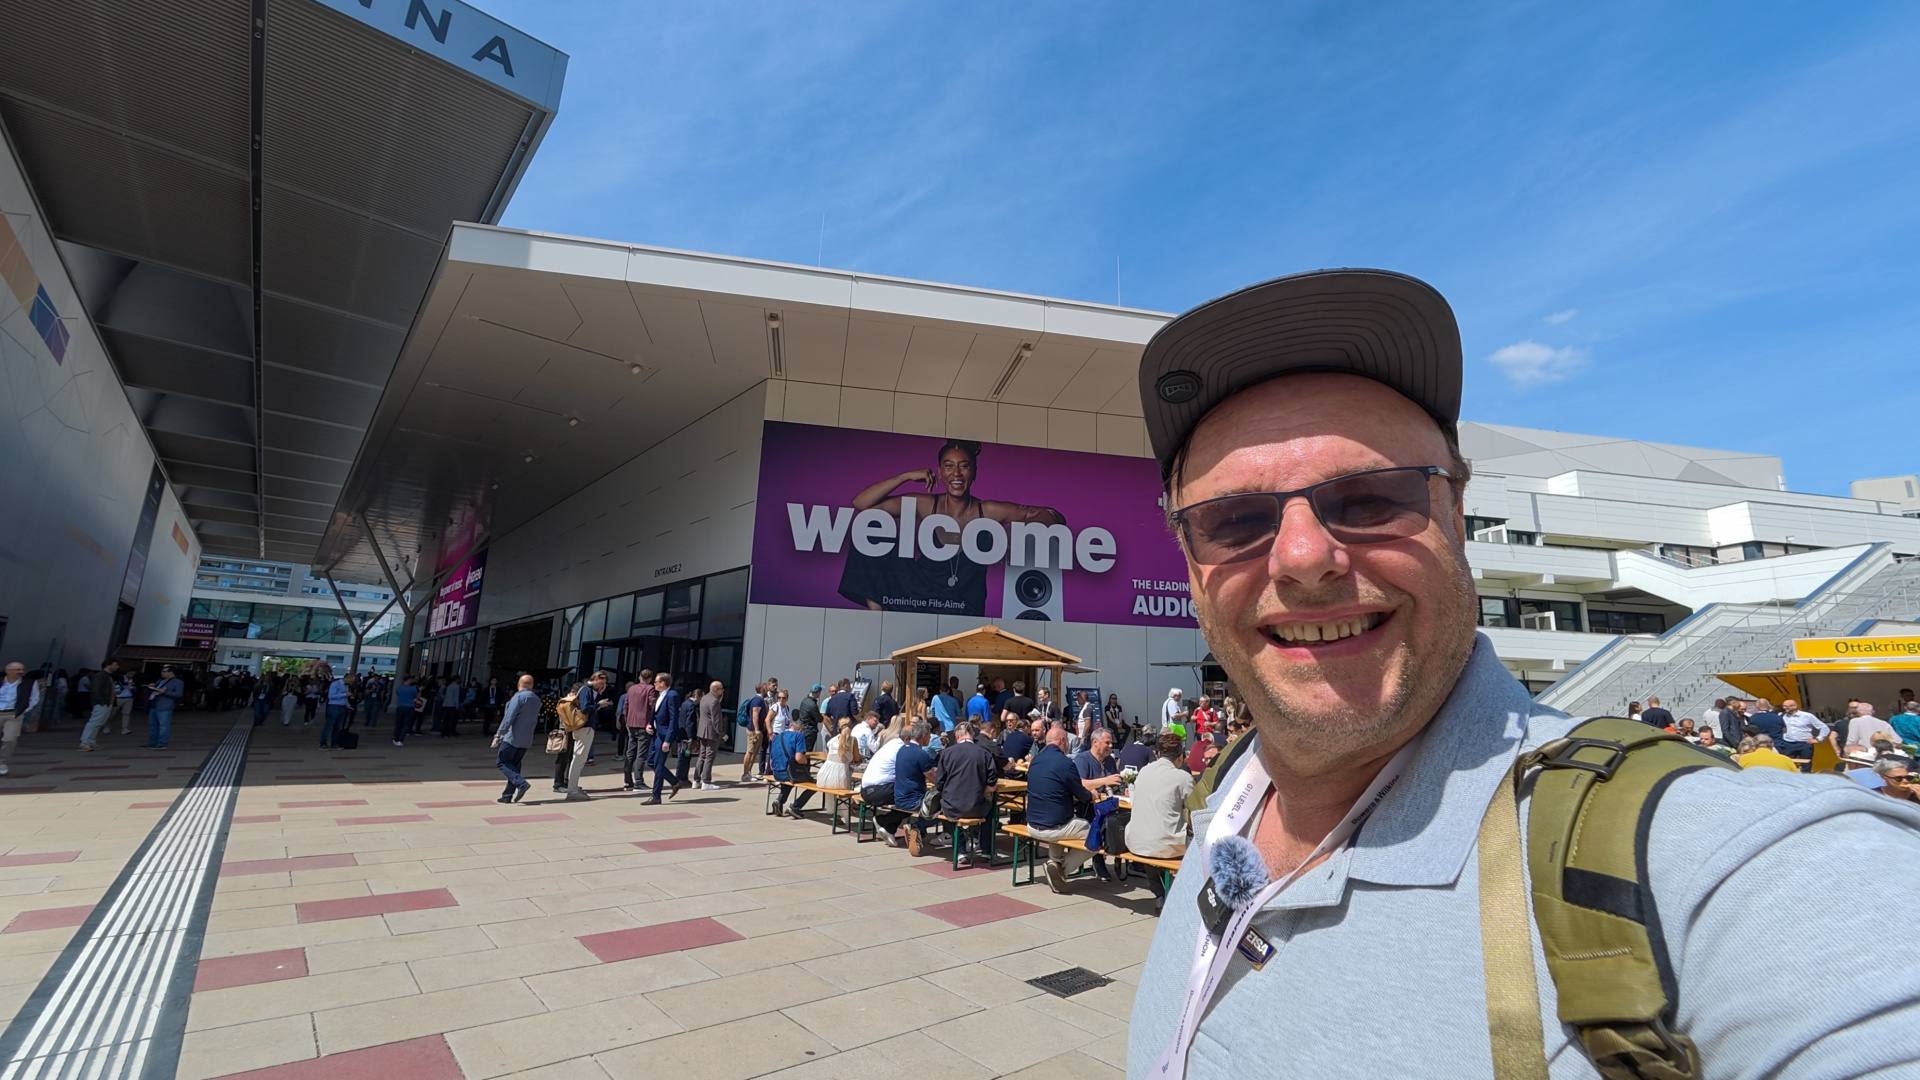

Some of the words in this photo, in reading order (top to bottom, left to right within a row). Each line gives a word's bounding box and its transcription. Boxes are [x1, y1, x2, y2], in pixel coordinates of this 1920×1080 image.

[357, 0, 515, 78] NA
[786, 496, 1117, 573] welcome
[1132, 579, 1152, 590] THE
[1153, 580, 1191, 593] LEADIN
[882, 595, 927, 608] Dominique
[928, 599, 965, 609] Fils-Aimé
[1231, 795, 1248, 812] LEVEL
